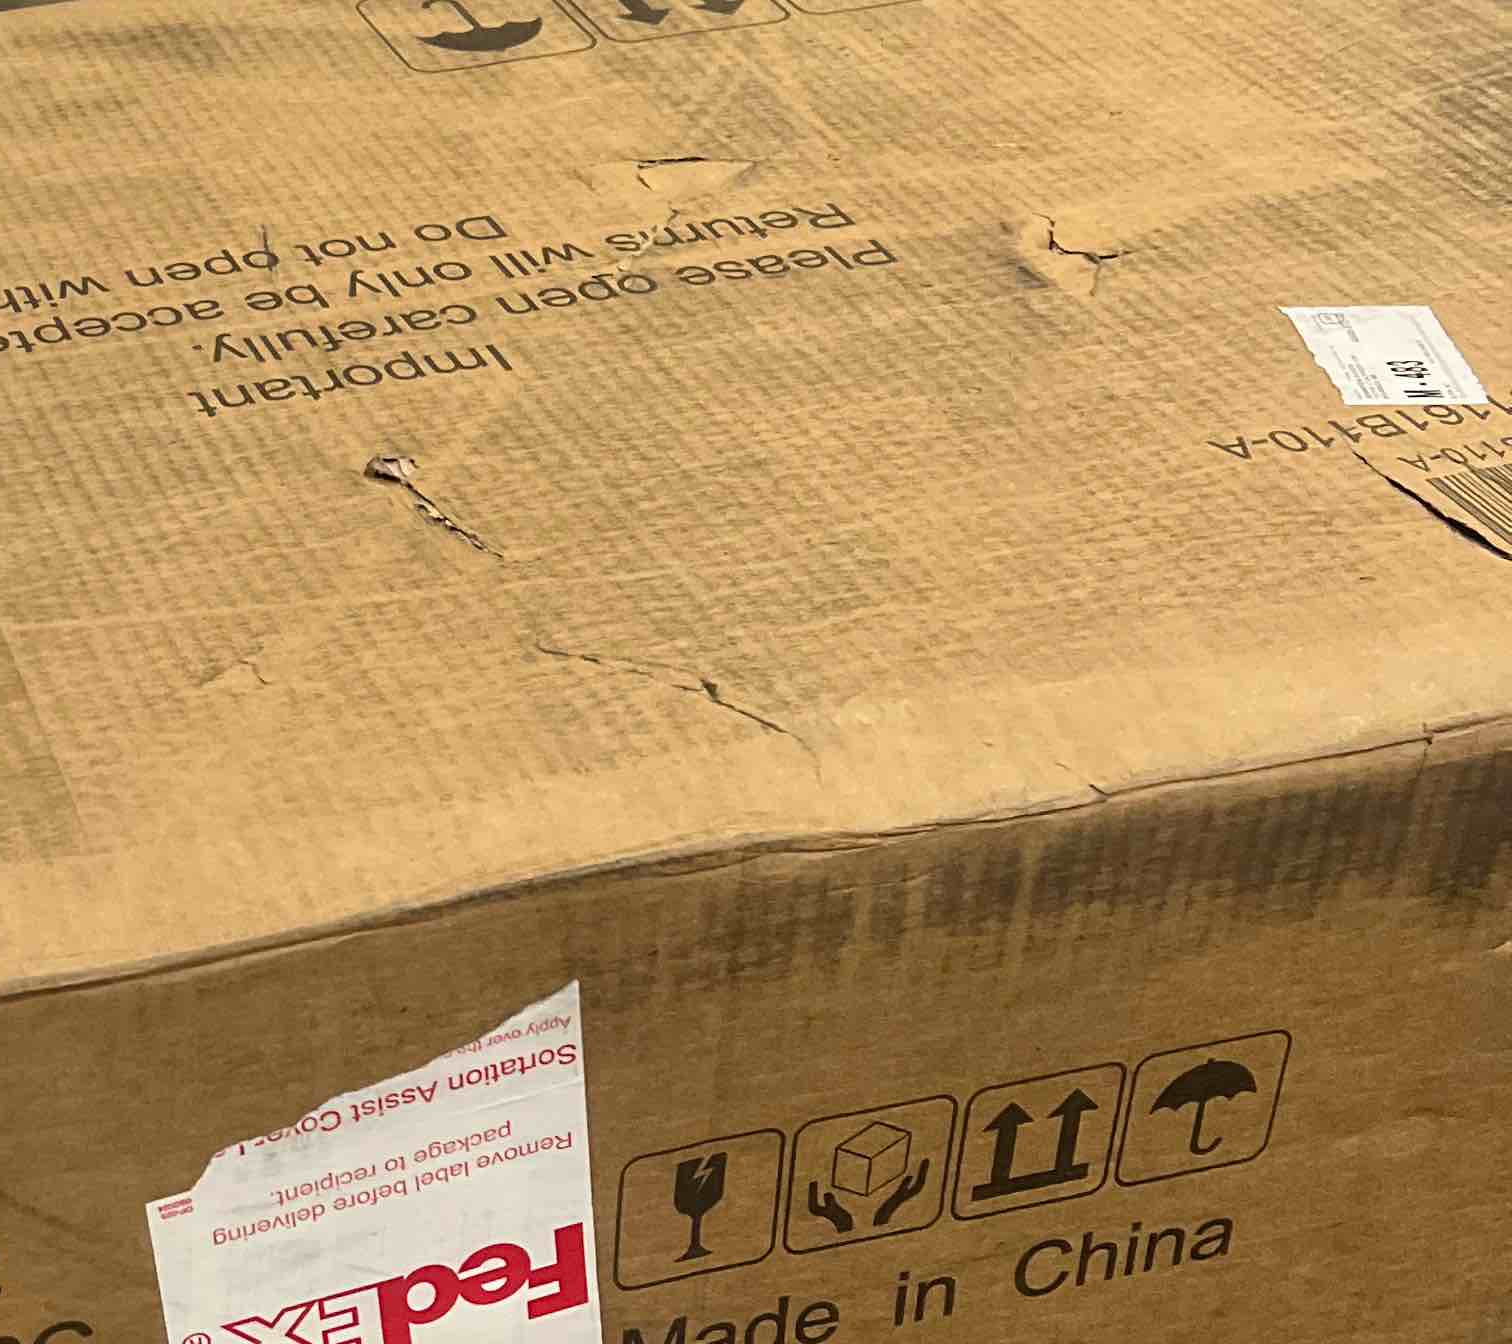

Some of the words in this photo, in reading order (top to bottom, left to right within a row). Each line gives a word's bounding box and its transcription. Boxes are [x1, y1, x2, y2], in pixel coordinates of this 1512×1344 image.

[294, 230, 397, 266] not
[414, 215, 508, 242] Do
[124, 248, 279, 288] open
[347, 260, 473, 299] only
[489, 239, 596, 282] will
[676, 239, 899, 288] Please
[243, 282, 329, 312] be
[495, 271, 659, 316] open
[191, 303, 479, 364] carefully.
[188, 343, 515, 417] Important
[1206, 393, 1512, 460] 1161B110-A
[486, 1029, 522, 1051] over
[526, 1014, 572, 1046] Apply
[447, 1042, 577, 1092] Sortation
[350, 1079, 437, 1123] Assist
[384, 1149, 406, 1173] to
[413, 1121, 512, 1165] package
[476, 1131, 572, 1173] Remove
[270, 1161, 376, 1204] recipient.
[333, 1178, 407, 1214] before
[414, 1160, 469, 1193] label
[212, 1204, 325, 1247] delivering
[893, 1270, 957, 1328] in
[1013, 1216, 1235, 1299] China
